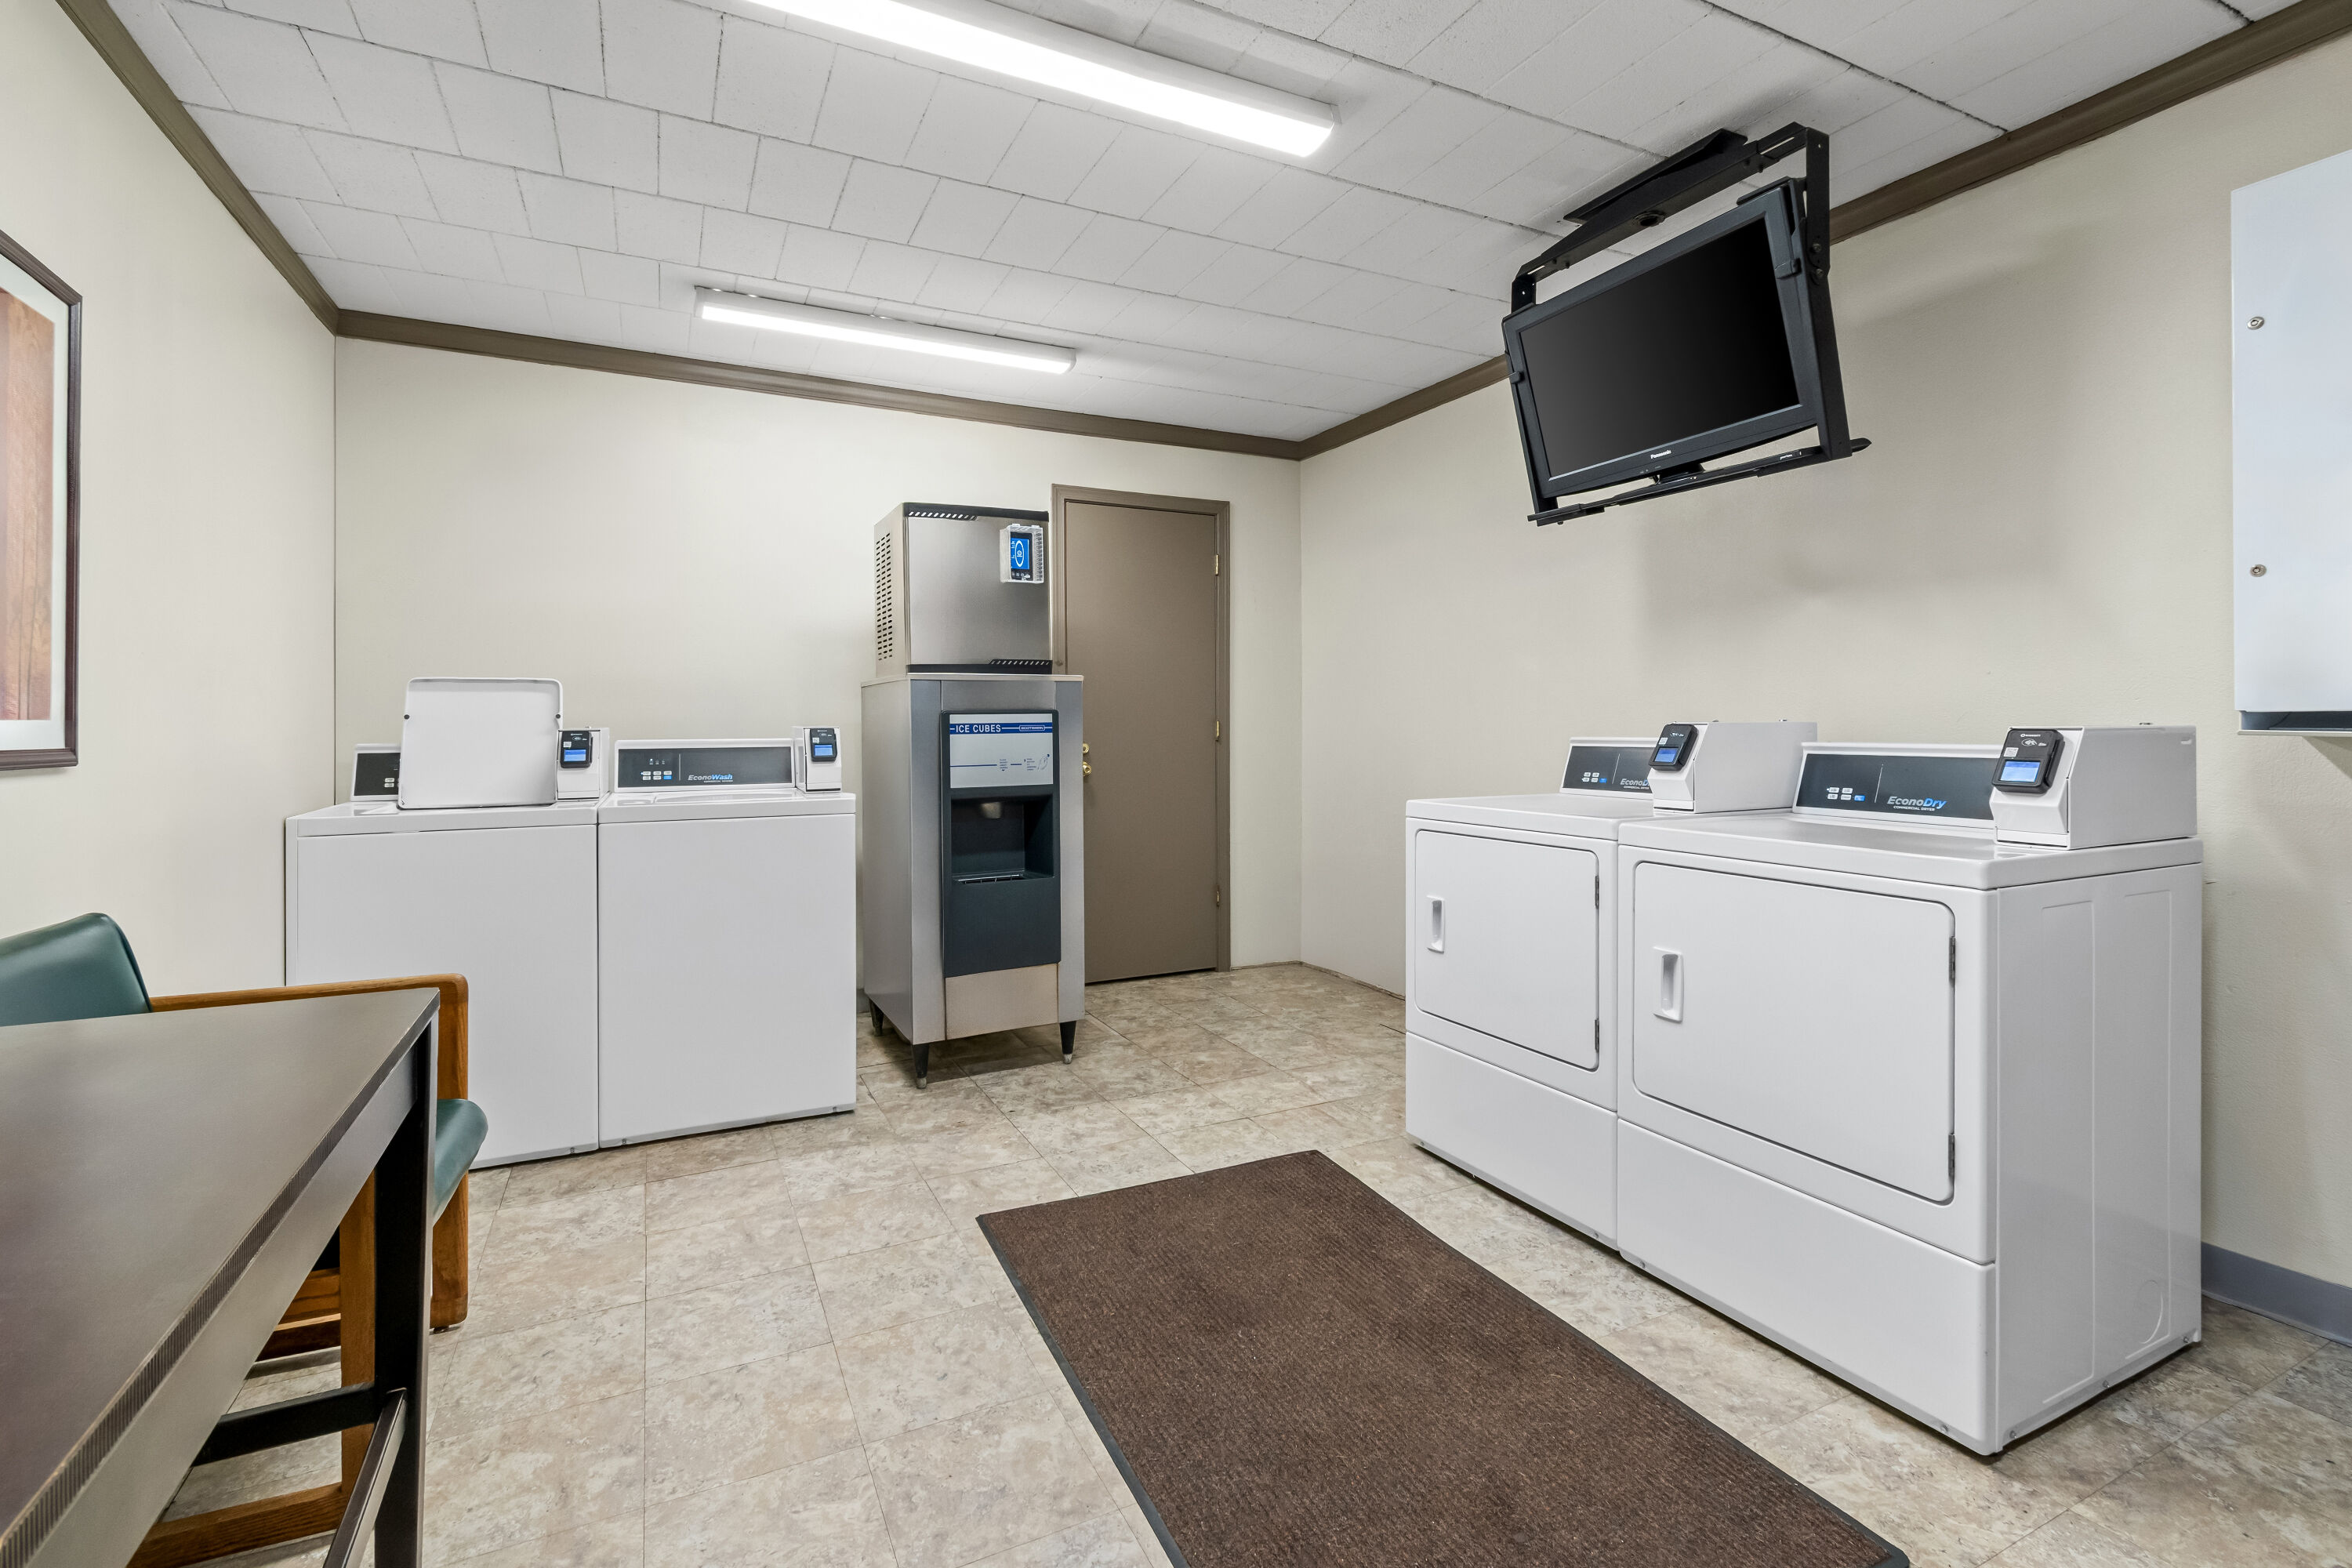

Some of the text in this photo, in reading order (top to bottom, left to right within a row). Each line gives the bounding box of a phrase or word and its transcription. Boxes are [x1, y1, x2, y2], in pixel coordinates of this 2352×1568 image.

[1650, 450, 1671, 459] Panasonic
[956, 724, 1001, 733] ICE CUBES
[1887, 796, 1947, 809] EconoDry
